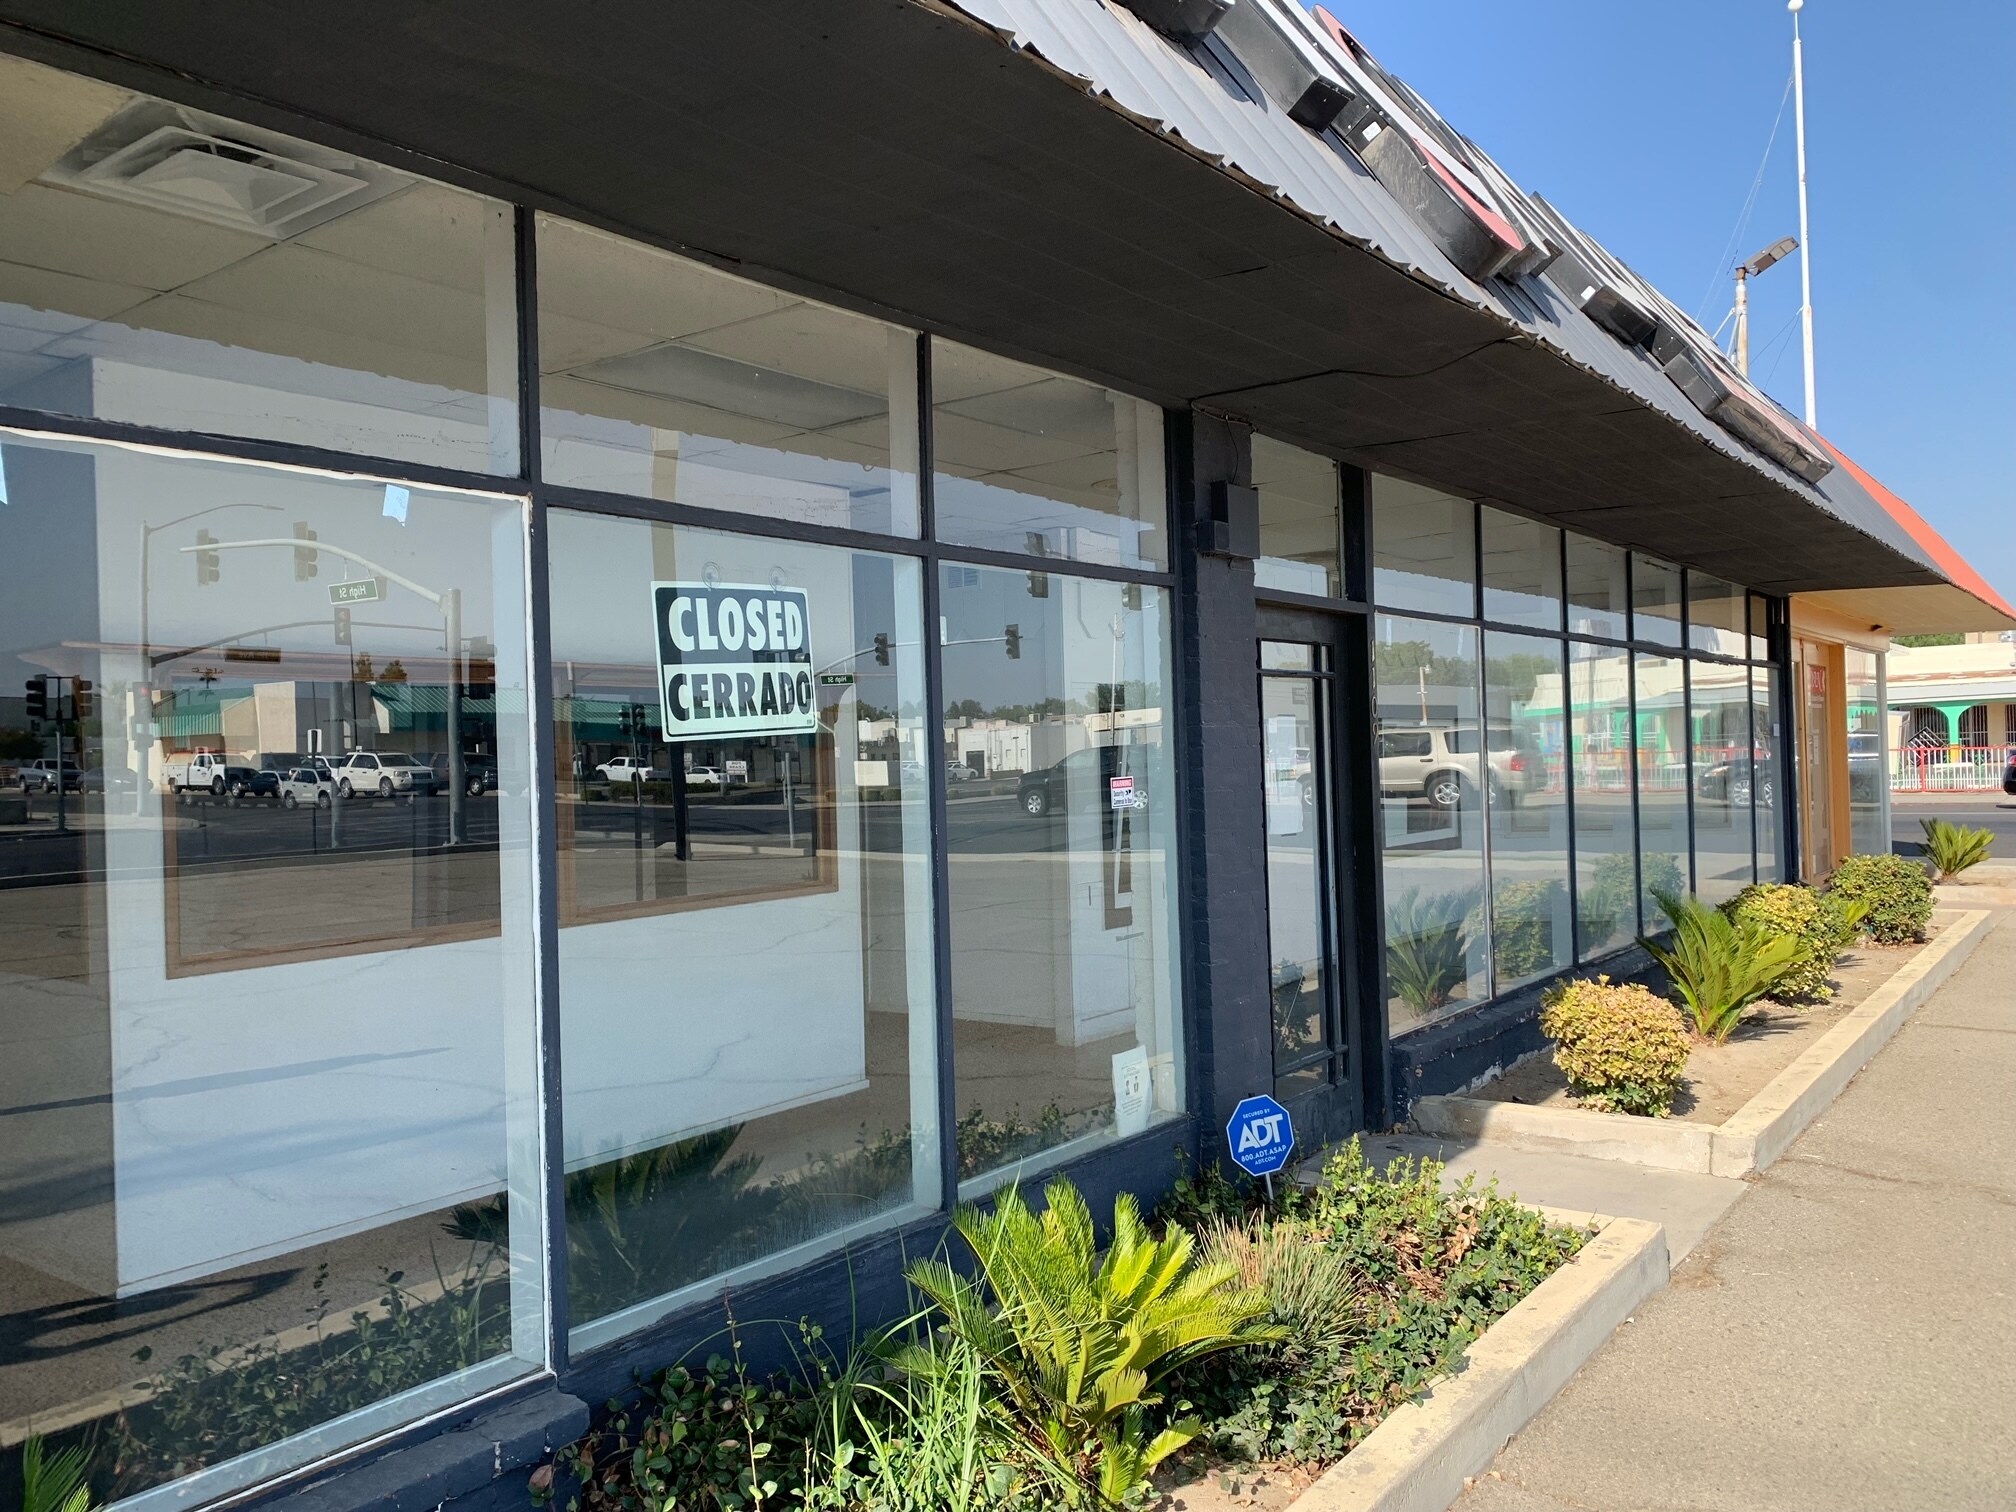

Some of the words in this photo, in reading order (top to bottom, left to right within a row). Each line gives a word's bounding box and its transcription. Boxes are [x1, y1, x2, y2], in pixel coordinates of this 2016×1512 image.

[668, 596, 803, 651] CLOSED
[668, 670, 812, 722] CERRADO
[1238, 1113, 1283, 1153] ADT
[1242, 1109, 1263, 1119] SECURED
